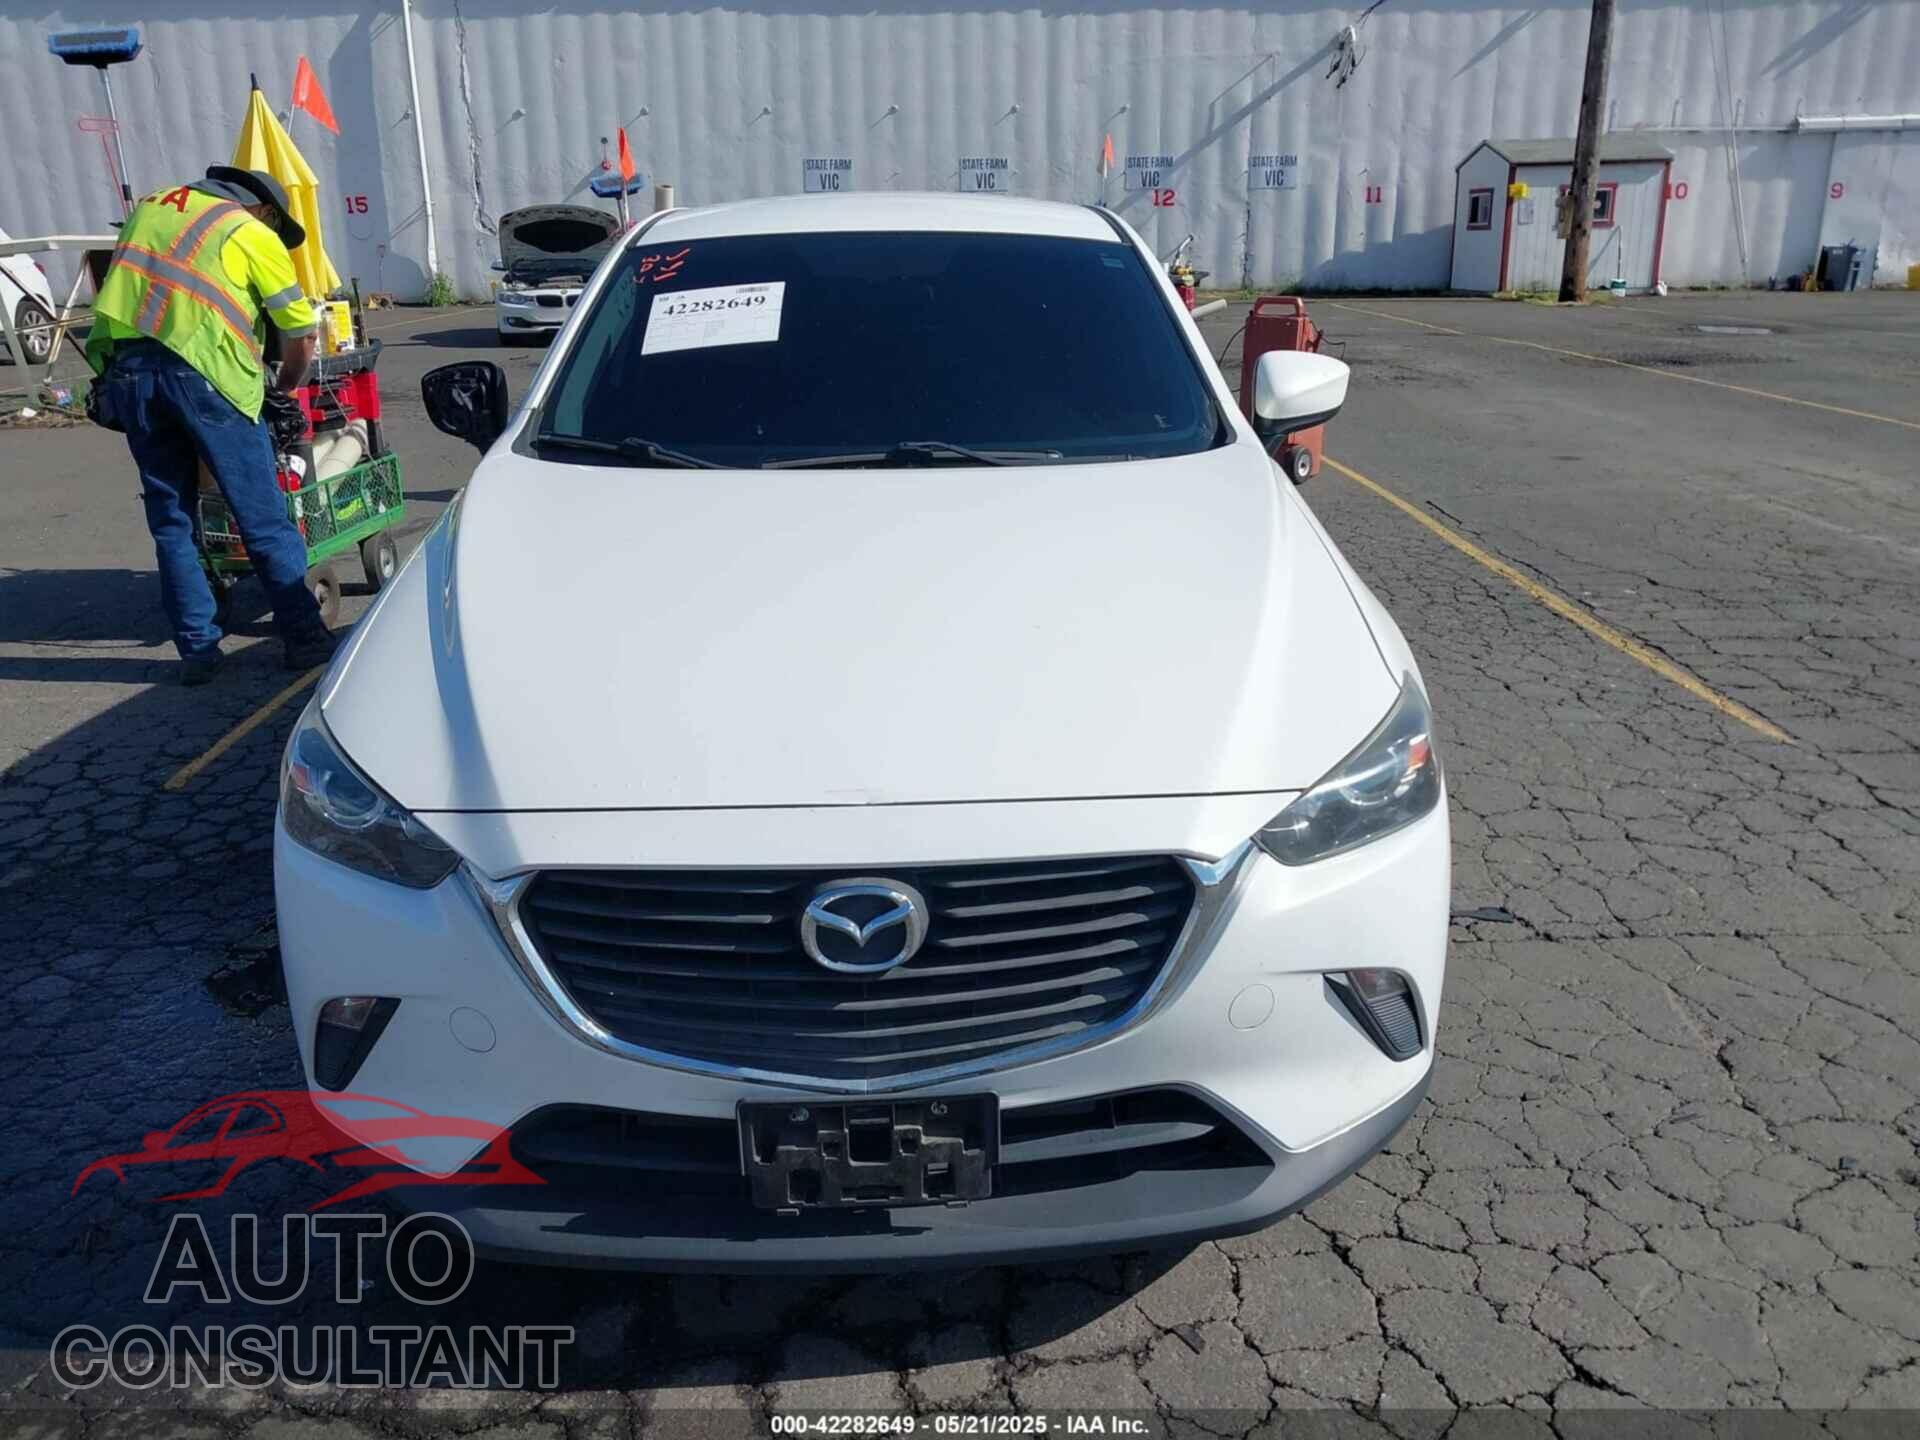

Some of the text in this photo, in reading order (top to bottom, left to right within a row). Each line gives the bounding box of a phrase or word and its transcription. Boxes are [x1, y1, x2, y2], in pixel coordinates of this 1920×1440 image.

[806, 159, 852, 170] STATE FARM
[962, 159, 1008, 170] STATE FARM
[1127, 156, 1174, 169] STATE FARM
[1252, 155, 1297, 168] STATE FARM
[819, 173, 839, 190] VIC
[975, 172, 995, 189] VIC
[1140, 170, 1160, 188] VIC
[1264, 170, 1284, 187] VIC
[1152, 189, 1175, 206] 12
[1365, 186, 1382, 203] 11
[1830, 182, 1844, 199] 9
[345, 196, 369, 214] 15
[663, 296, 766, 315] 42282649
